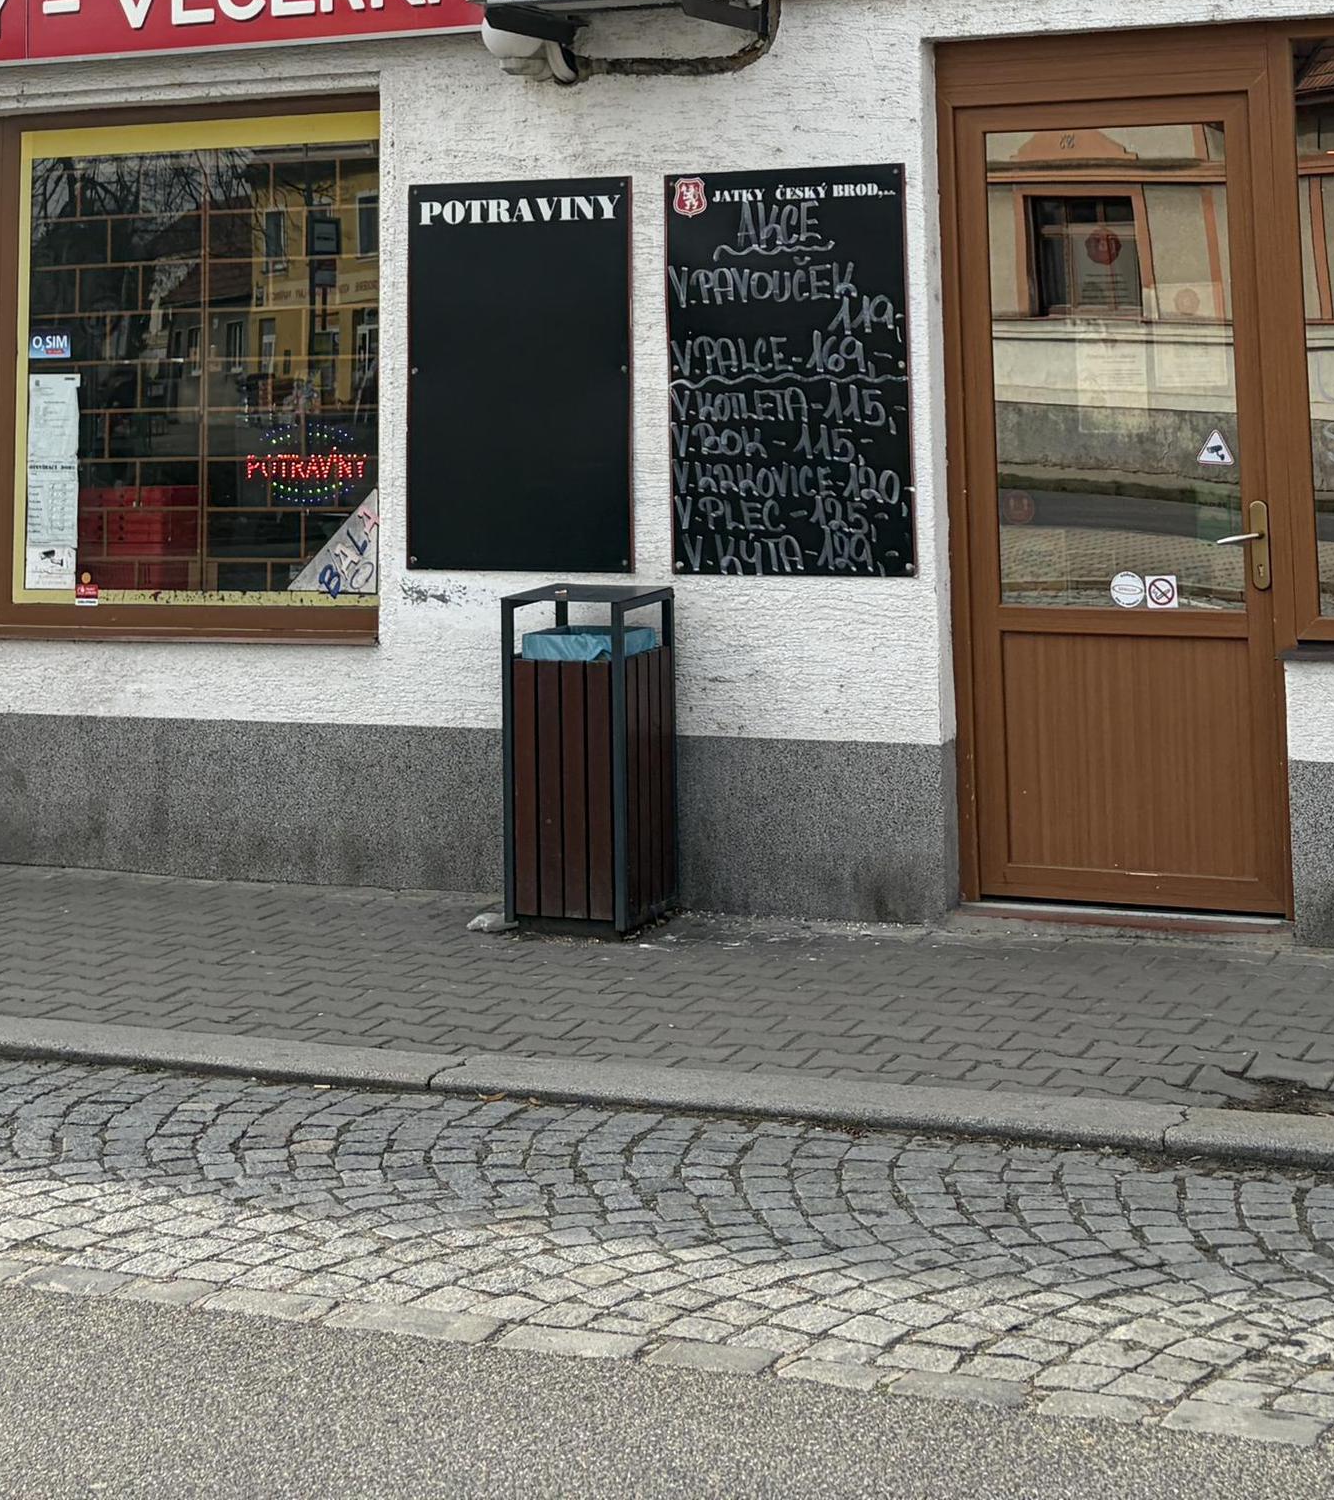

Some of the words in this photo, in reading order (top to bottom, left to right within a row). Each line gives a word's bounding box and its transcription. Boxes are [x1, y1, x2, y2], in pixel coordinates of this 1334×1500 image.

[712, 188, 767, 203] JATKY
[775, 182, 829, 200] ČESKÝ
[419, 194, 622, 226] POTRAVINY
[737, 200, 823, 248] AKCE
[45, 334, 68, 349] SIM
[319, 504, 380, 600] BALA
